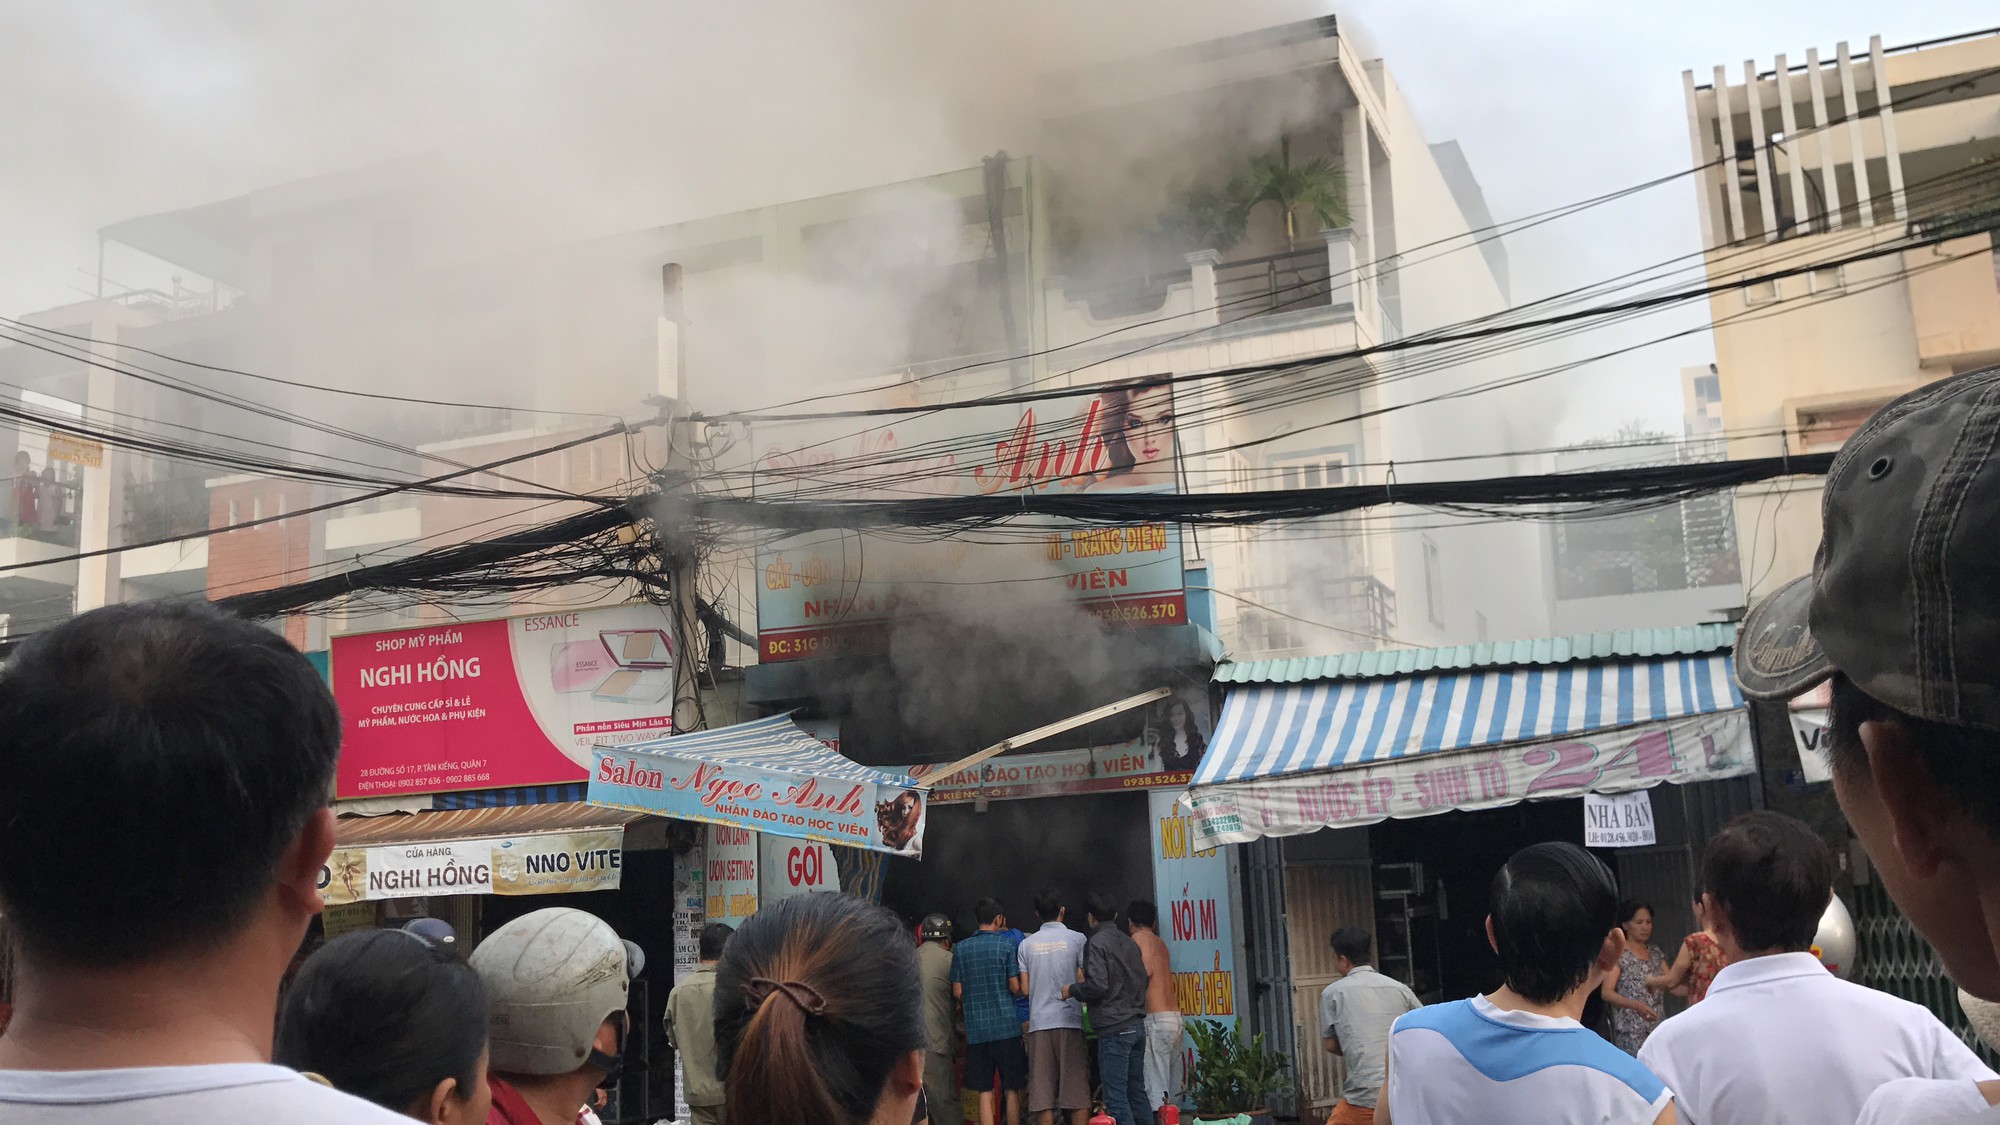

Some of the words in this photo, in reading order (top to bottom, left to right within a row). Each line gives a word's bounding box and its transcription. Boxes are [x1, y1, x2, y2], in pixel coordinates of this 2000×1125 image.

[974, 398, 1114, 495] Anh
[1071, 527, 1123, 558] TRANG
[1064, 567, 1127, 590] VIÊN
[524, 613, 579, 632] ESSANCE
[376, 639, 406, 652] SHOP
[409, 634, 426, 648] MỸ
[769, 640, 791, 655] ĐC:
[794, 638, 818, 652] 31G
[360, 664, 411, 688] NGHI
[418, 655, 481, 682] HỒNG
[372, 703, 403, 715] CHUYÊN
[404, 701, 426, 712] CUNG
[428, 698, 444, 710] CẤP
[454, 699, 460, 707] &
[358, 717, 370, 728] MỸ
[398, 713, 421, 725] NƯỚC
[423, 713, 440, 723] HOA
[442, 712, 448, 721] &
[449, 710, 466, 721] PHỤ
[467, 708, 486, 720] KIỆN
[613, 721, 630, 729] Siêu
[632, 720, 647, 728] Mịn
[649, 718, 663, 726] Lâu
[575, 737, 592, 746] VEIL
[612, 733, 633, 743] TWO
[637, 732, 656, 741] WAY
[360, 769, 369, 777] 28
[369, 767, 394, 777] ĐƯỜNG
[396, 764, 405, 774] SỐ
[424, 763, 437, 771] TÂN
[483, 760, 487, 768] 7
[1103, 753, 1145, 773] VIÊN
[398, 779, 414, 788] 0902
[415, 778, 427, 786] 857
[428, 777, 441, 785] 636
[445, 775, 462, 784] 0902
[477, 773, 490, 781] 668
[597, 755, 663, 791] Salon
[670, 762, 763, 807] Ngọc
[772, 777, 865, 817] Anh
[1124, 772, 1193, 787] 0938.526.37
[1296, 775, 1360, 824] NƯỚC
[1362, 768, 1395, 816] ÉP
[1414, 765, 1471, 809] SINH
[1474, 749, 1510, 800] TỐ
[715, 803, 749, 818] NHẬN
[752, 808, 778, 822] ĐÀO
[781, 813, 805, 828] TẠO
[808, 817, 834, 832] HỌC
[838, 821, 869, 837] VIÊN
[1588, 797, 1620, 828] NHÀ
[1624, 795, 1650, 828] BÁN
[405, 846, 424, 858] CỬA
[426, 846, 451, 858] HÀNG
[526, 852, 570, 874] NNO
[575, 849, 621, 871] VITE
[370, 868, 420, 890] NGHI
[428, 858, 490, 886] HỒNG
[727, 860, 754, 881] SETTING
[1171, 881, 1197, 941] NỐI
[1201, 899, 1218, 940] MI
[1203, 950, 1234, 1016] ĐIỂM
